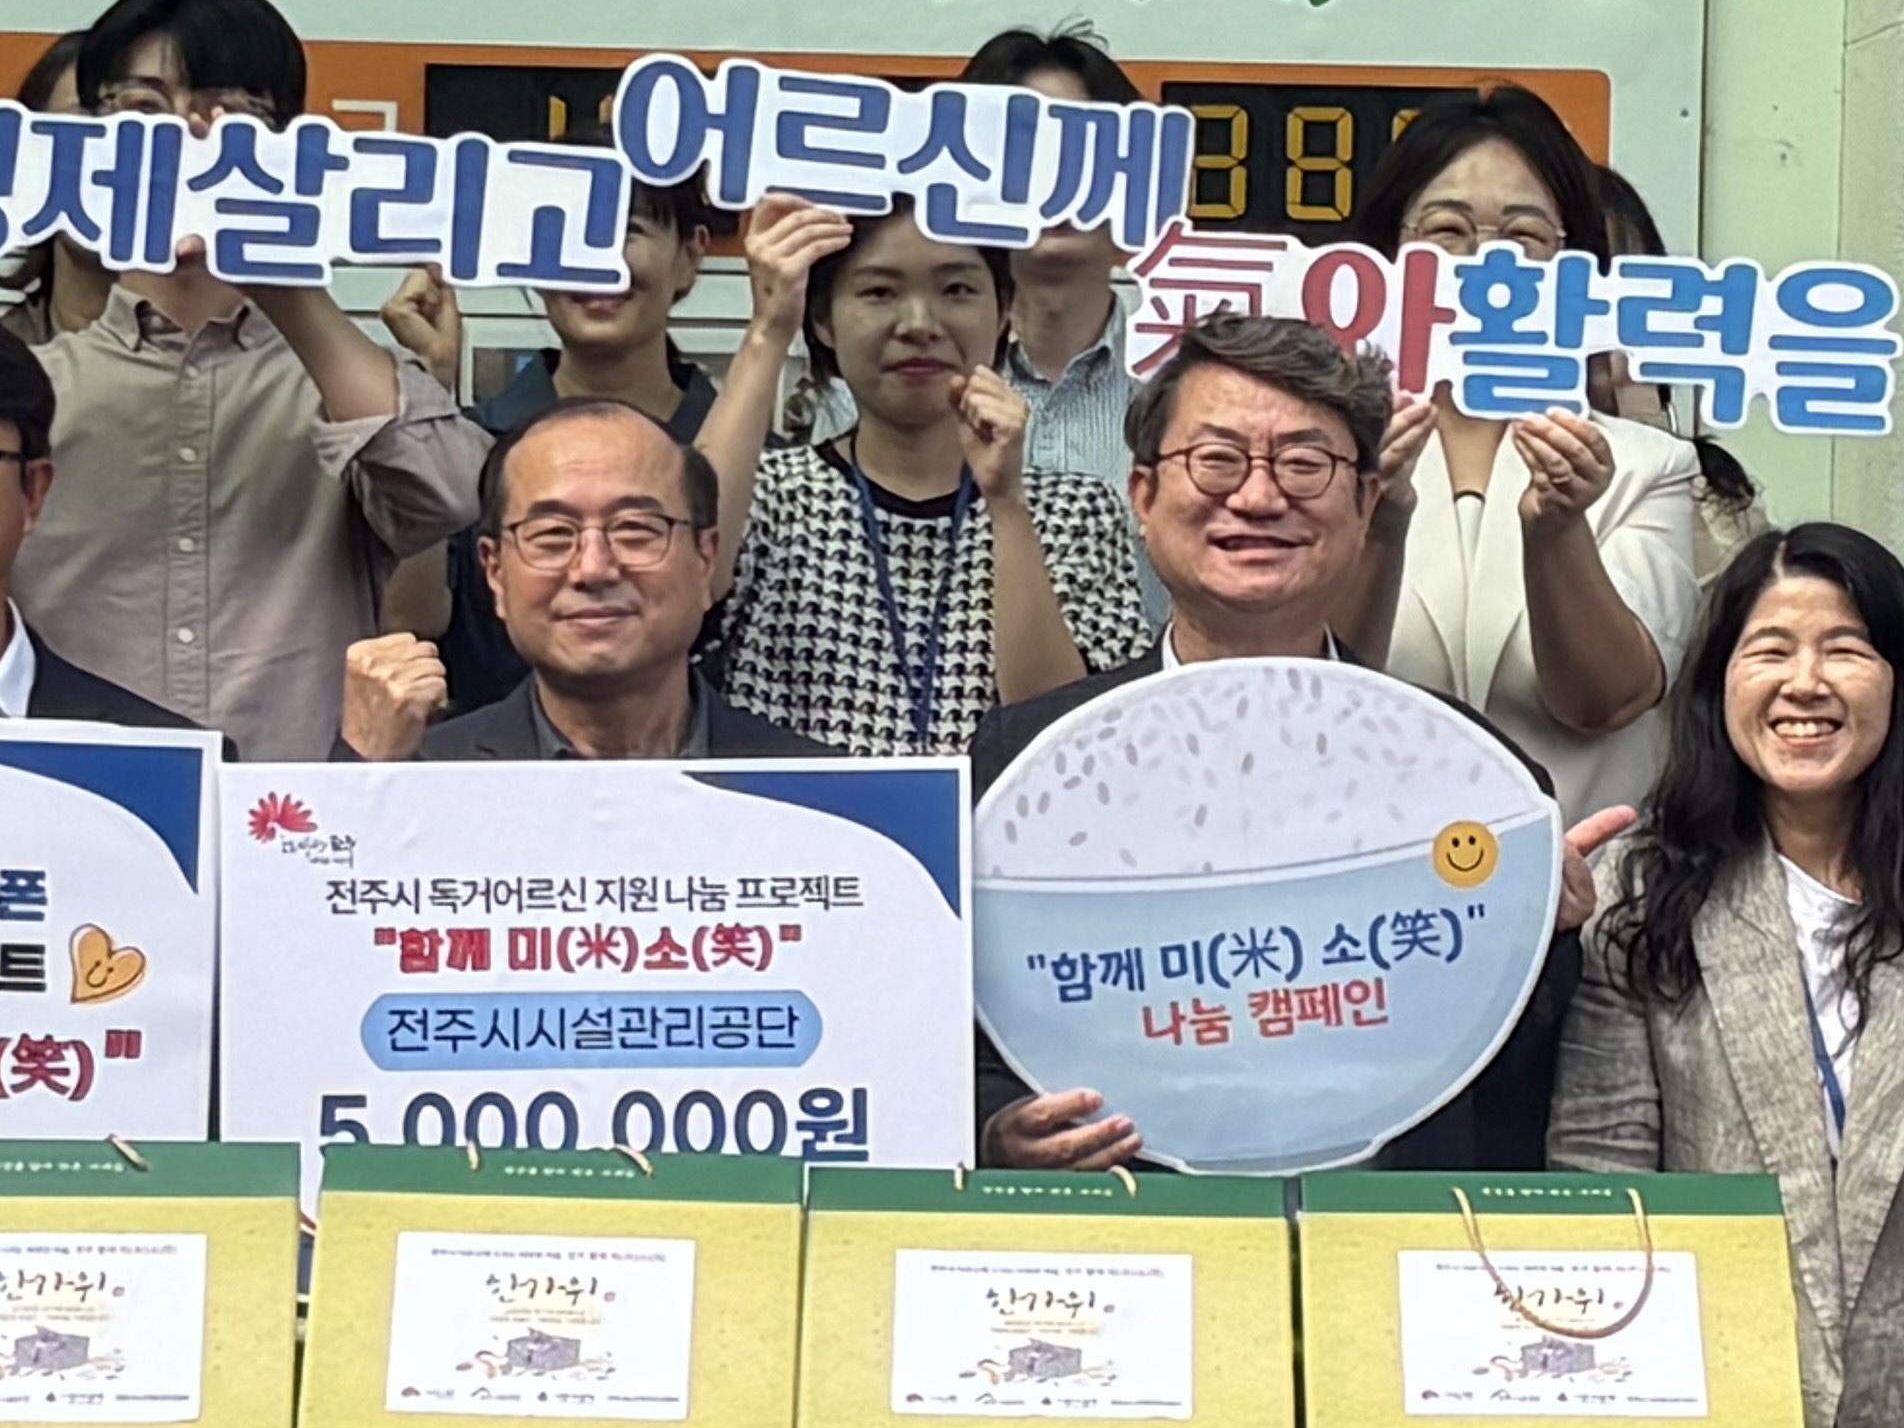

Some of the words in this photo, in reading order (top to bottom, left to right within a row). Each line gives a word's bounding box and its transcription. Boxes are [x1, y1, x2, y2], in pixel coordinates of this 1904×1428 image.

[618, 60, 1192, 246] 어르신께
[326, 878, 420, 915] 전주시
[428, 878, 587, 913] 독거어르신
[596, 877, 659, 912] 지원
[664, 876, 730, 912] 나눔
[736, 876, 864, 910] 프로젝트
[1027, 948, 1146, 1003] "함께
[387, 1005, 800, 1054] 전주시시설관리공단
[1142, 998, 1232, 1046] 나눔
[1248, 977, 1389, 1038] 캠페인
[319, 1087, 870, 1162] 5000000원
[486, 1273, 598, 1305] 한가위
[986, 1287, 1096, 1318] 한가위
